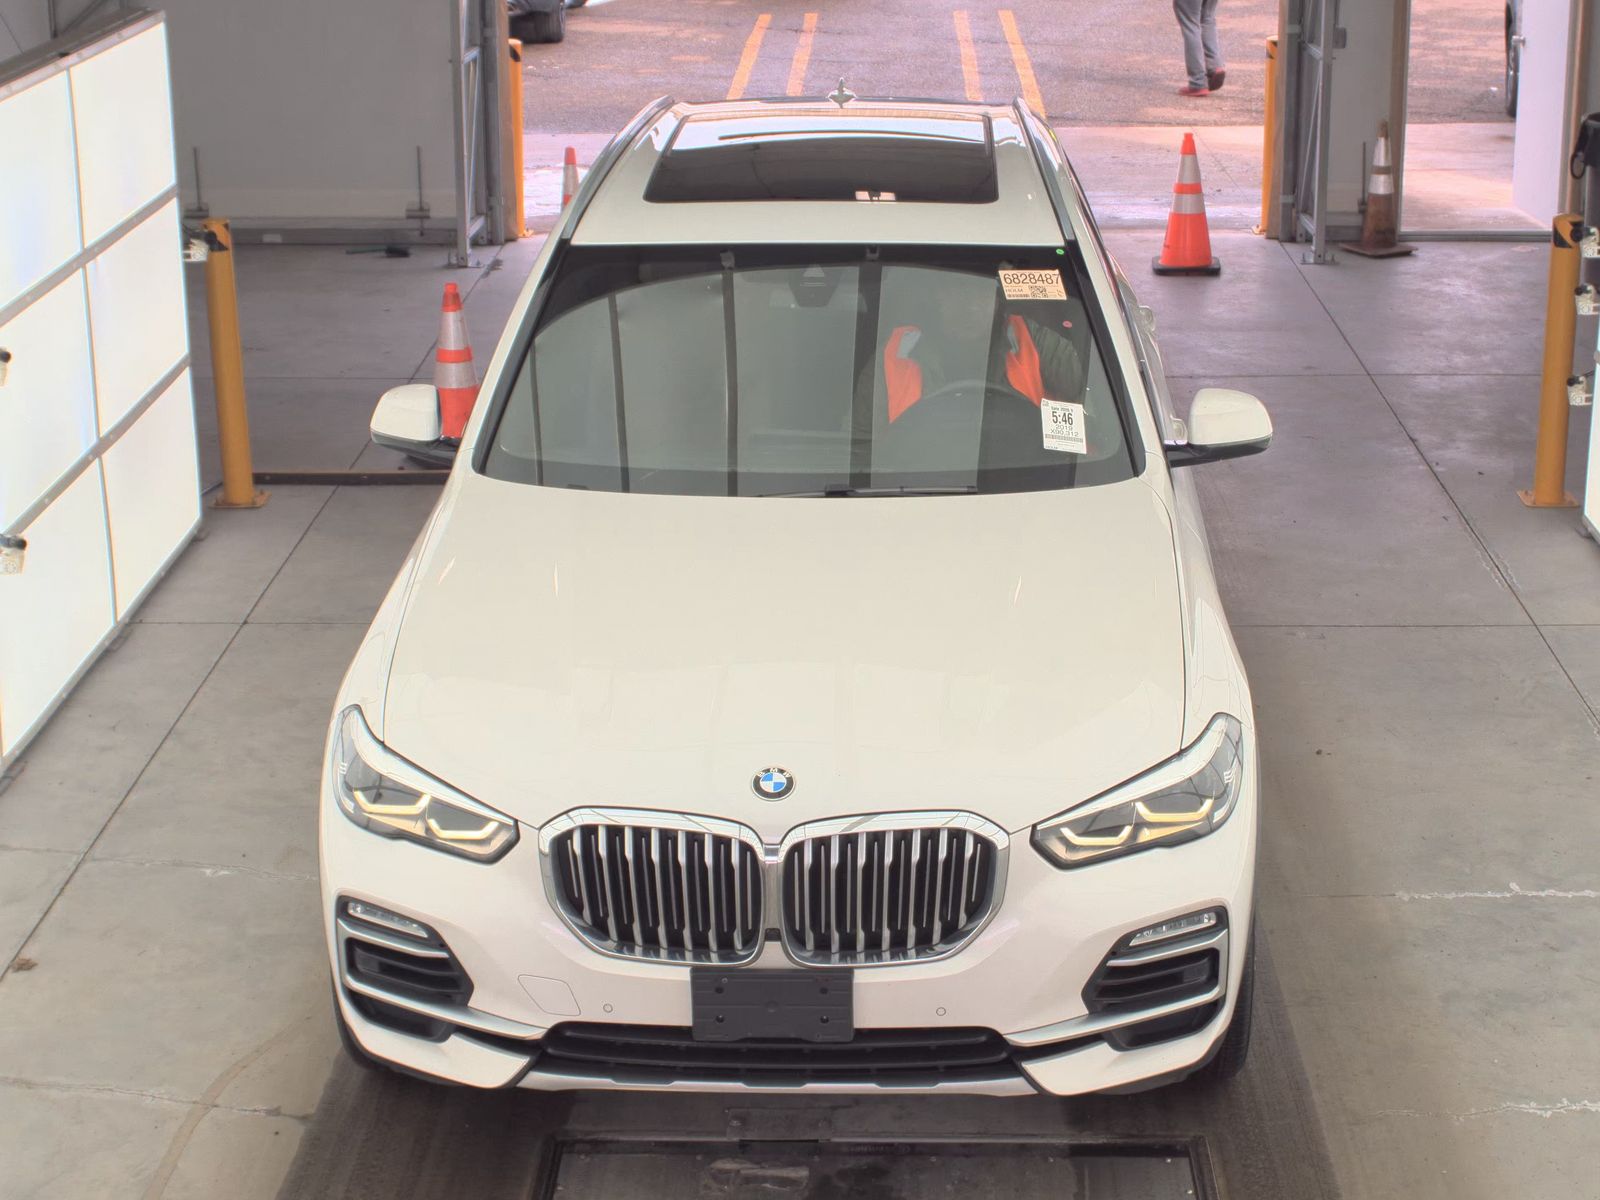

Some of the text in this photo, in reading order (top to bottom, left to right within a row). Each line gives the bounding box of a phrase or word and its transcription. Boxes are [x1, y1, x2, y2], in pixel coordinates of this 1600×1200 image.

[1003, 273, 1060, 285] 6828487
[1051, 411, 1074, 425] 5:46
[756, 767, 792, 778] BMW
